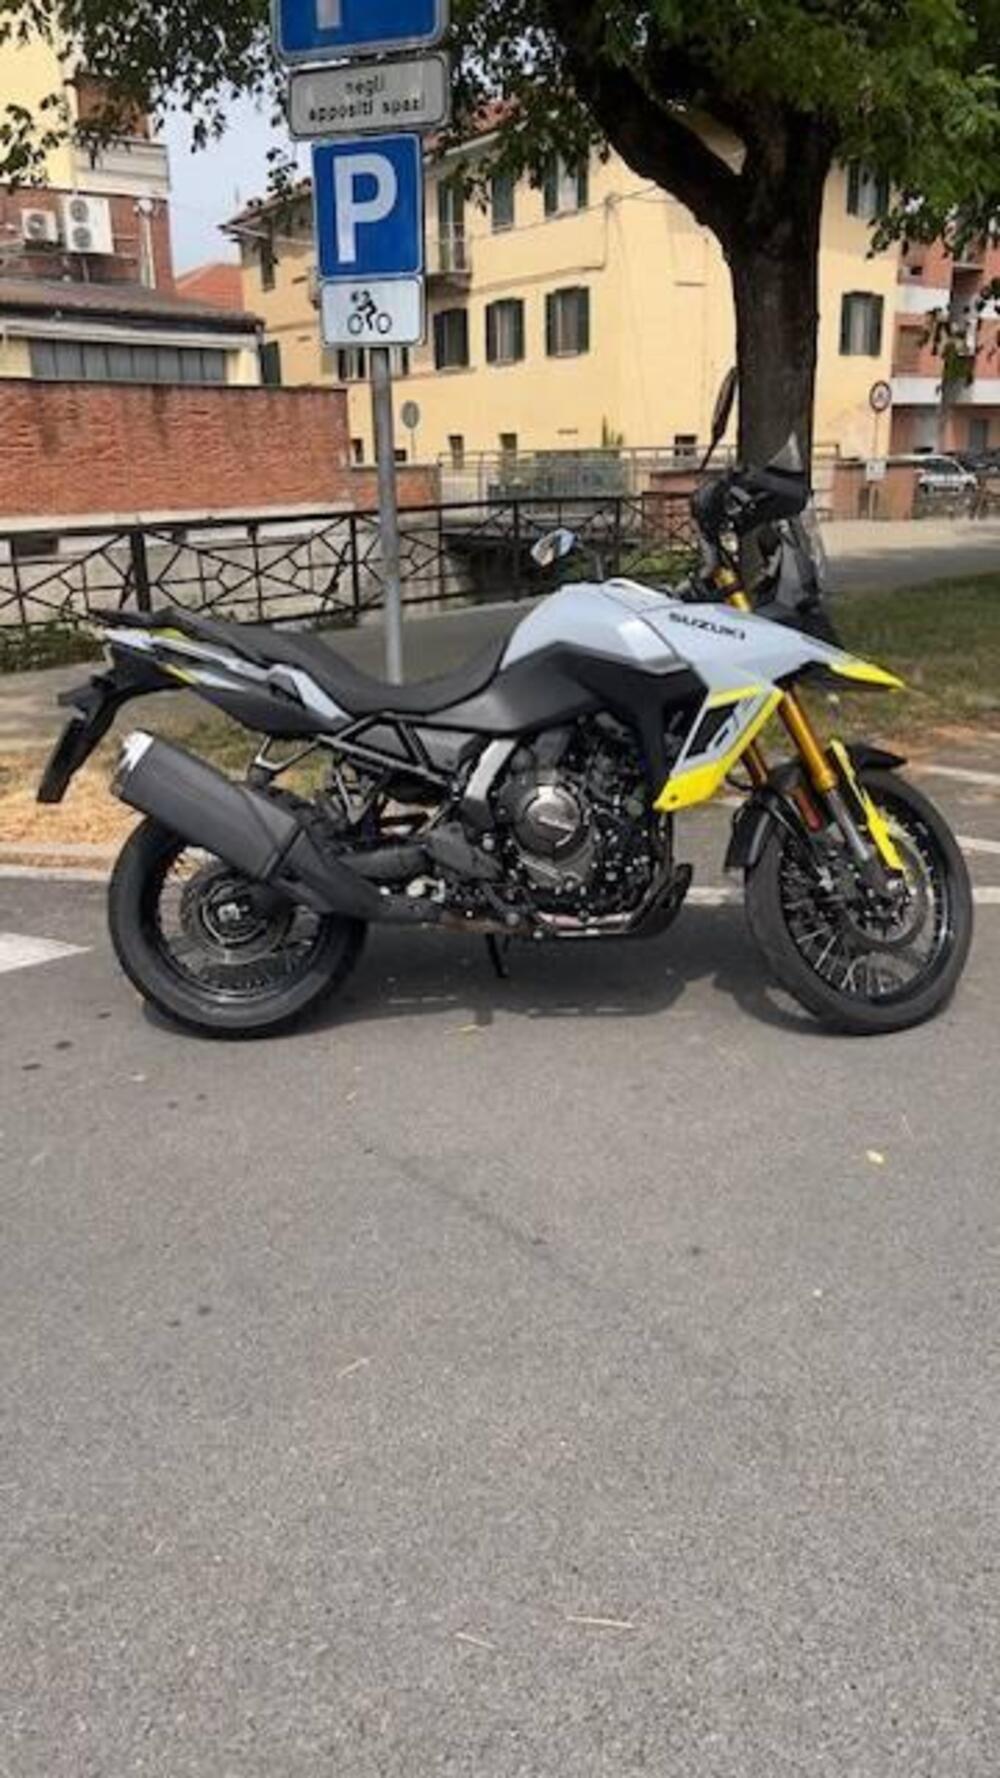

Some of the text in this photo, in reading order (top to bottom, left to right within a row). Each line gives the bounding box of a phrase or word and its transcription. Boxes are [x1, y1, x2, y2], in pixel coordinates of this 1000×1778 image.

[345, 75, 384, 98] negli
[309, 91, 425, 122] appositi spazi
[332, 153, 397, 264] P
[669, 611, 746, 641] SUZUKI
